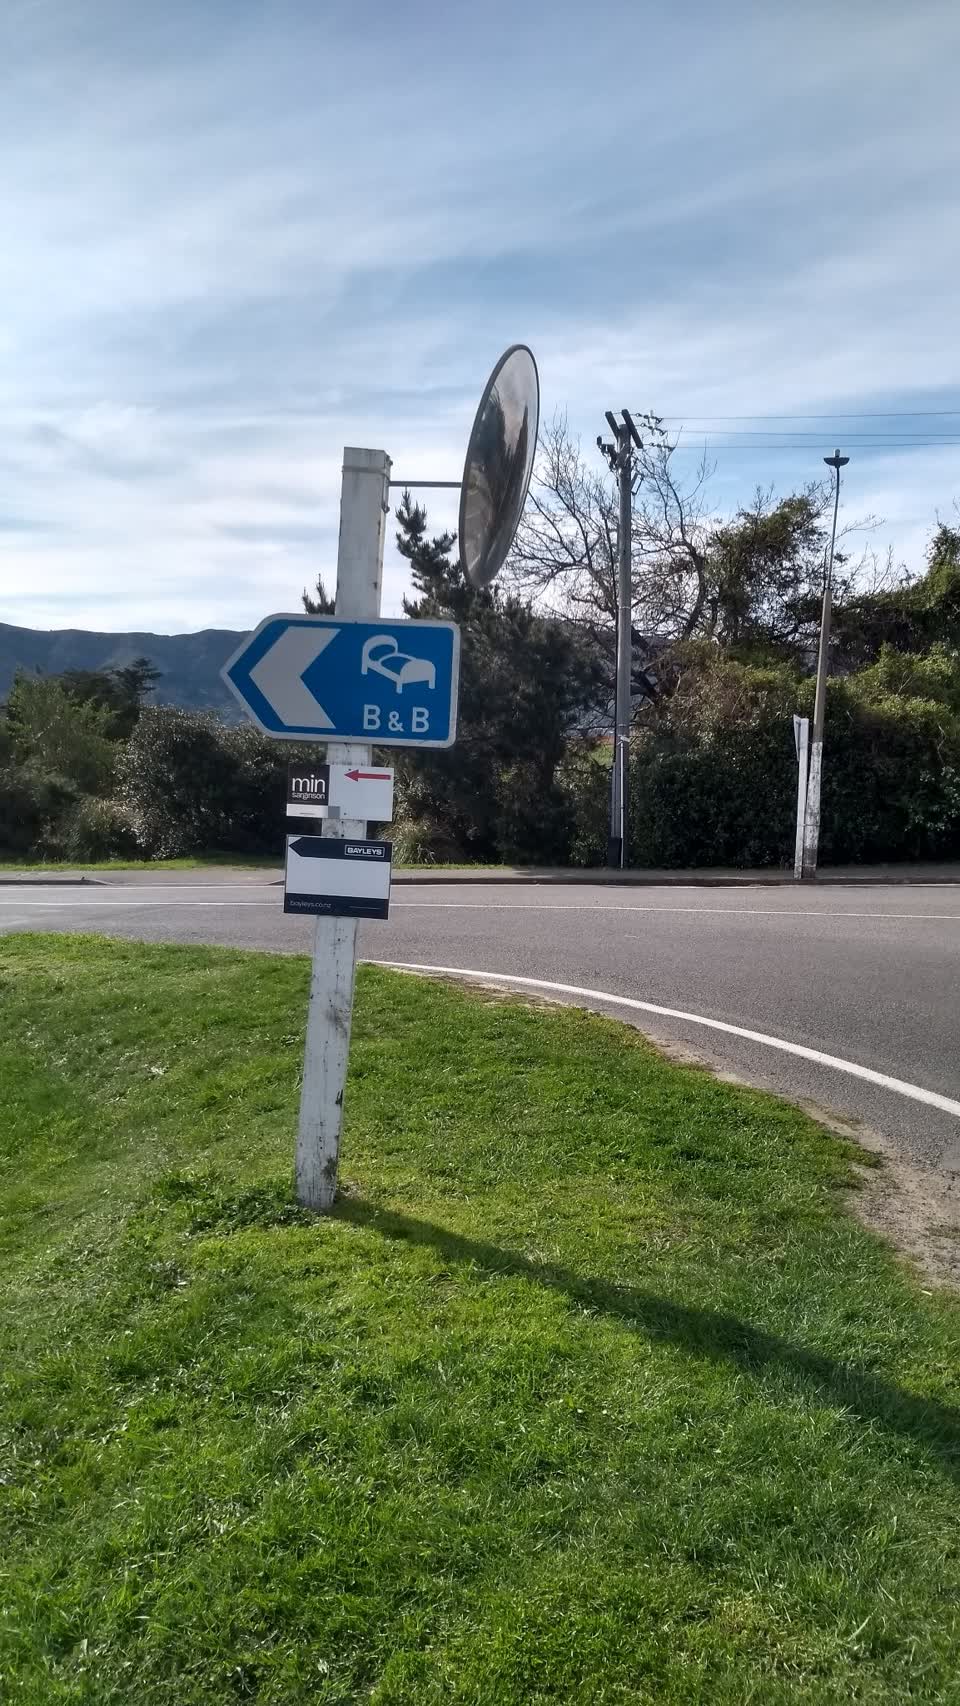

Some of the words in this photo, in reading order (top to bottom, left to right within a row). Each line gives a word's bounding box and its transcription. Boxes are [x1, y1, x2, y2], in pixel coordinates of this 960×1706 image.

[363, 704, 381, 730] B
[388, 710, 404, 732] &
[411, 706, 430, 733] B
[292, 774, 326, 793] min
[347, 847, 382, 856] BAYLEYS
[290, 900, 332, 909] bayleys.co.nz
